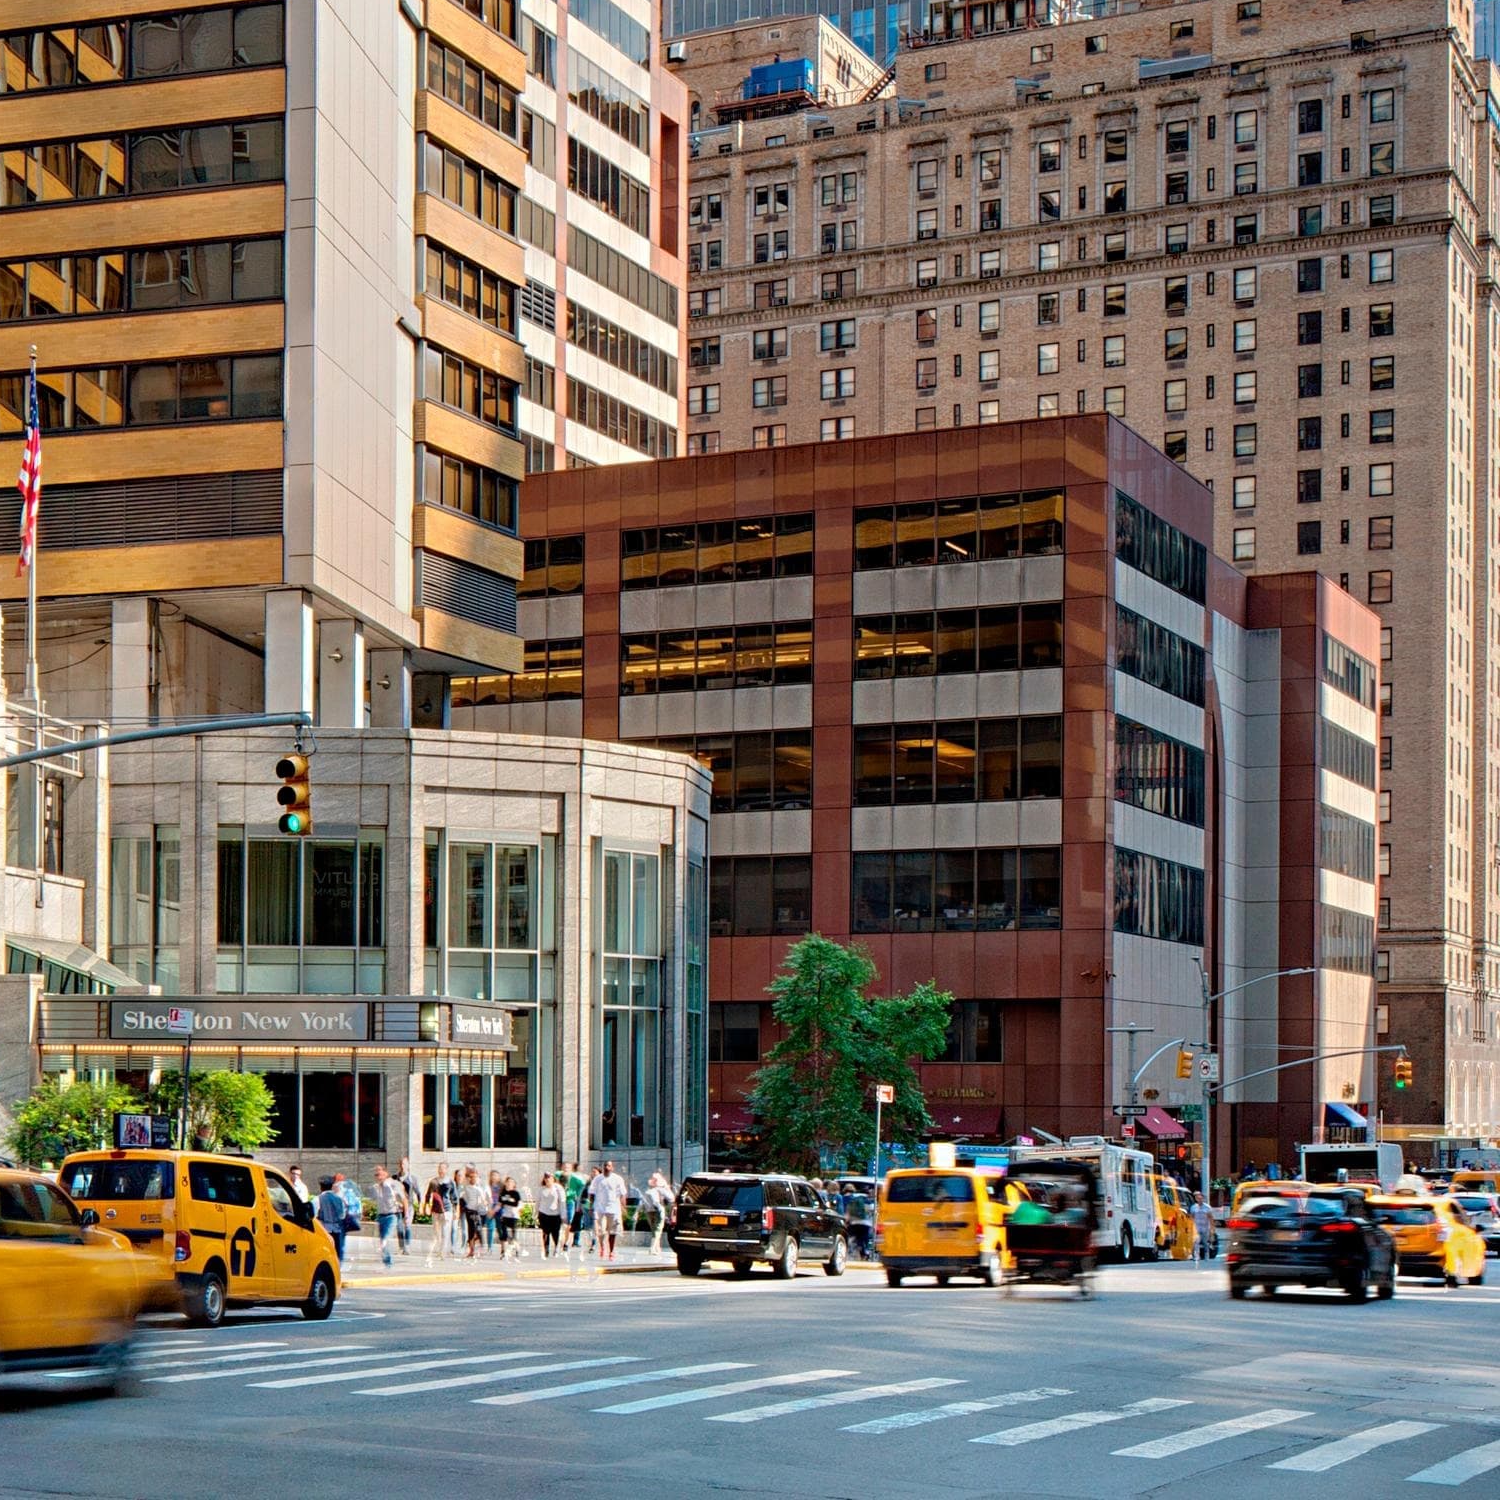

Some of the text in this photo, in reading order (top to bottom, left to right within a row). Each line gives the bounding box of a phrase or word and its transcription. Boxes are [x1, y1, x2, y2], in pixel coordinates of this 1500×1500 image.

[123, 1010, 232, 1031] Sheton
[242, 1011, 293, 1031] New
[300, 1011, 353, 1031] York
[284, 1243, 297, 1254] NYC
